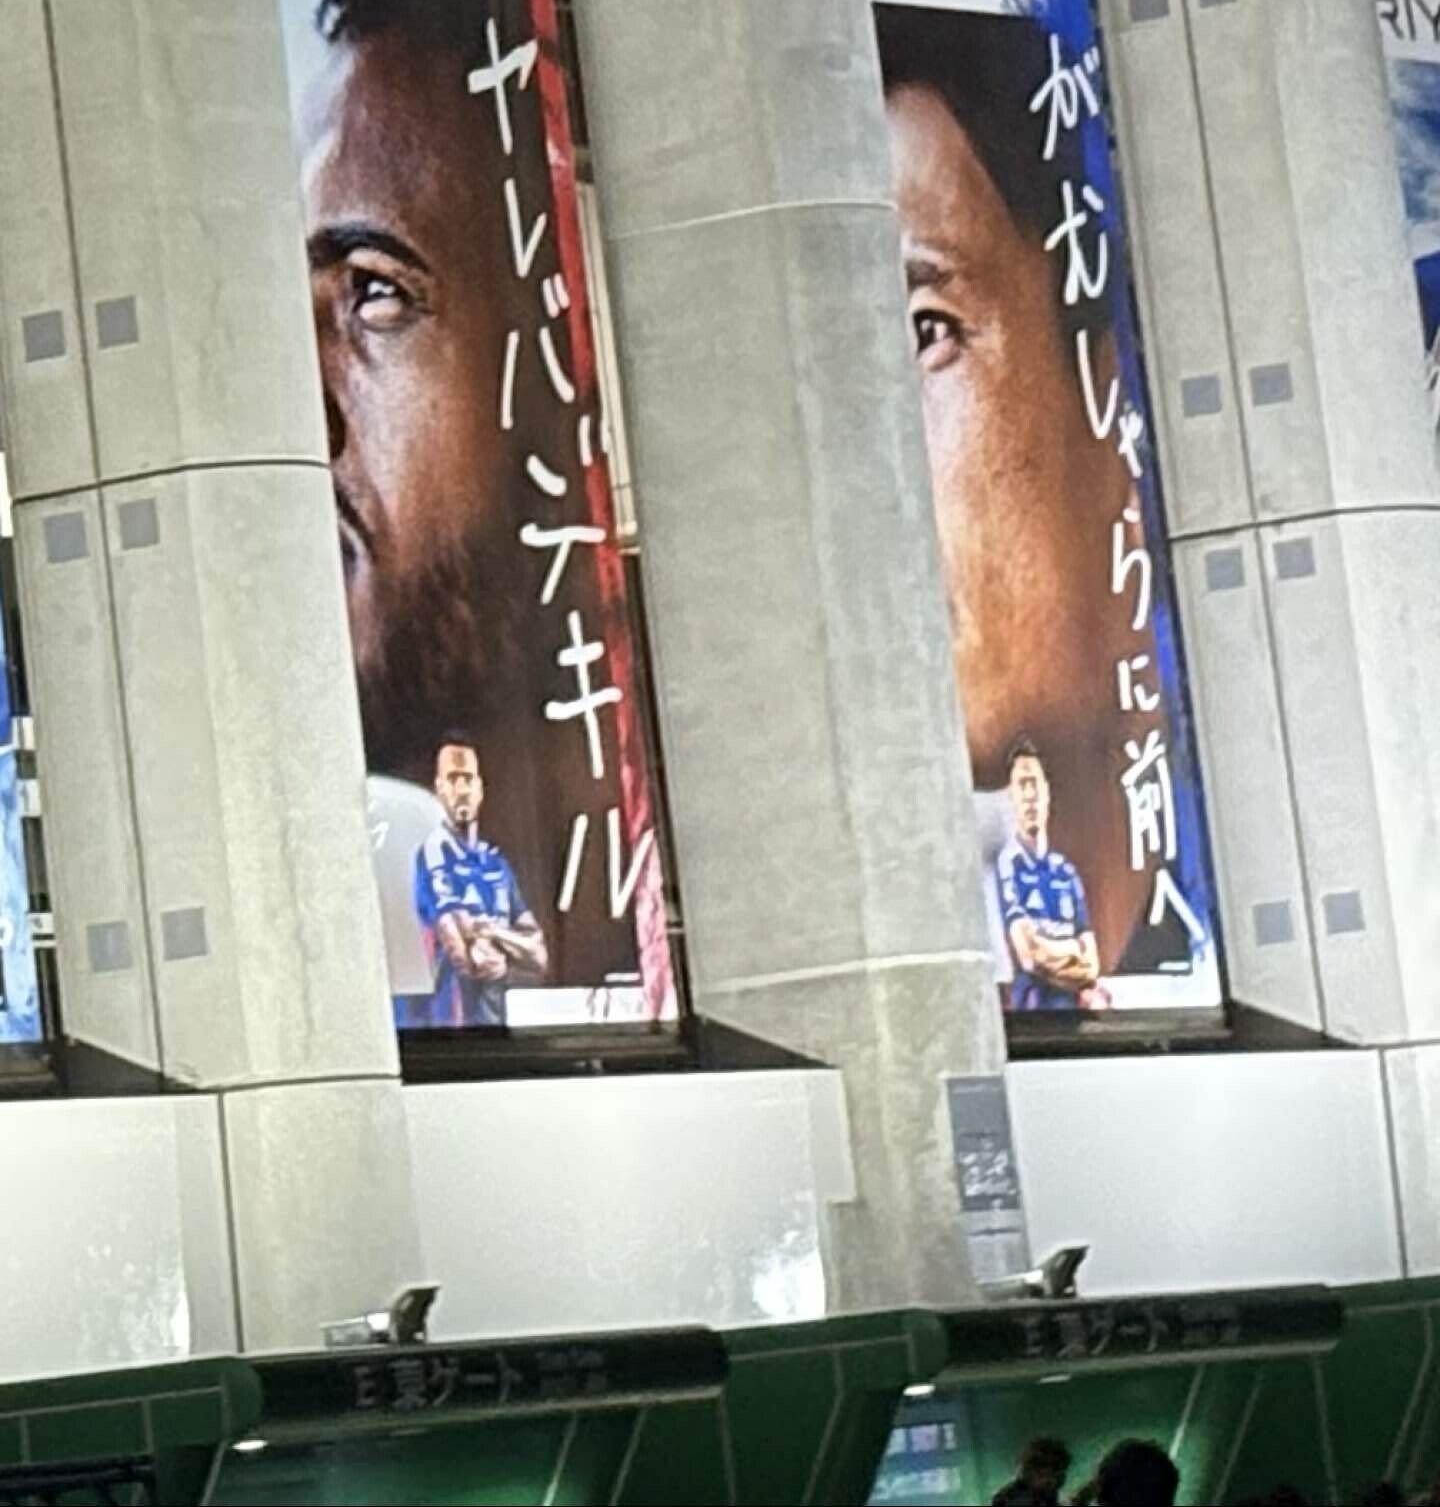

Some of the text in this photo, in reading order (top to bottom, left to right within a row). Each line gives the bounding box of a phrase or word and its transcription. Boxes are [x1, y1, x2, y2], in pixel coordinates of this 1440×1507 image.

[466, 16, 657, 920] ヤレバデキル
[1028, 32, 1208, 944] がむしゃらに前へ
